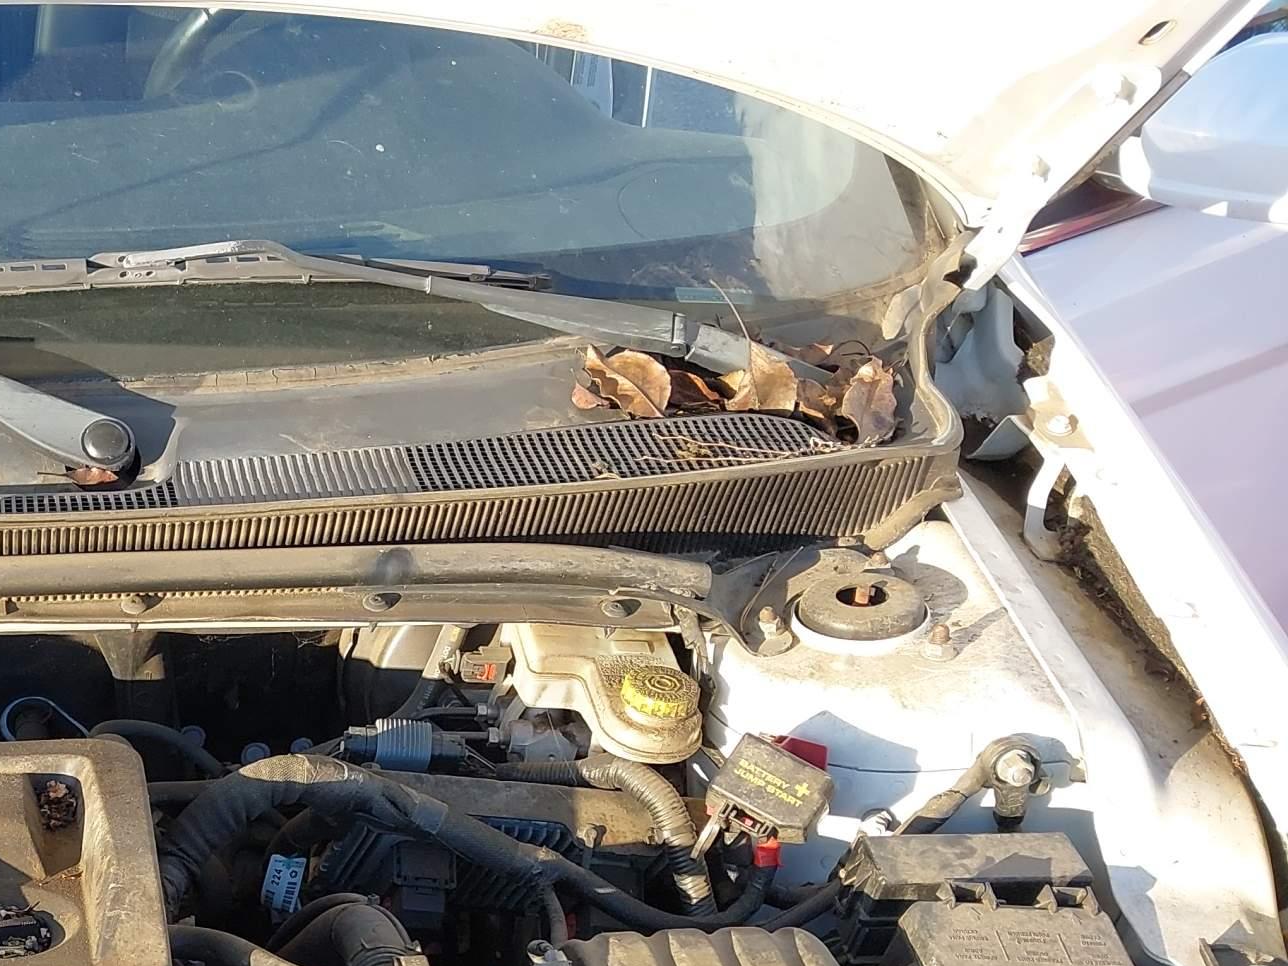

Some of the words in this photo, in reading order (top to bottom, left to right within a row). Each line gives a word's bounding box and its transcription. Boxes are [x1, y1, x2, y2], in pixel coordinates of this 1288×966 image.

[734, 768, 766, 787] JUMP
[765, 784, 804, 807] START
[738, 759, 790, 790] BATTERY
[270, 868, 283, 887] 224
